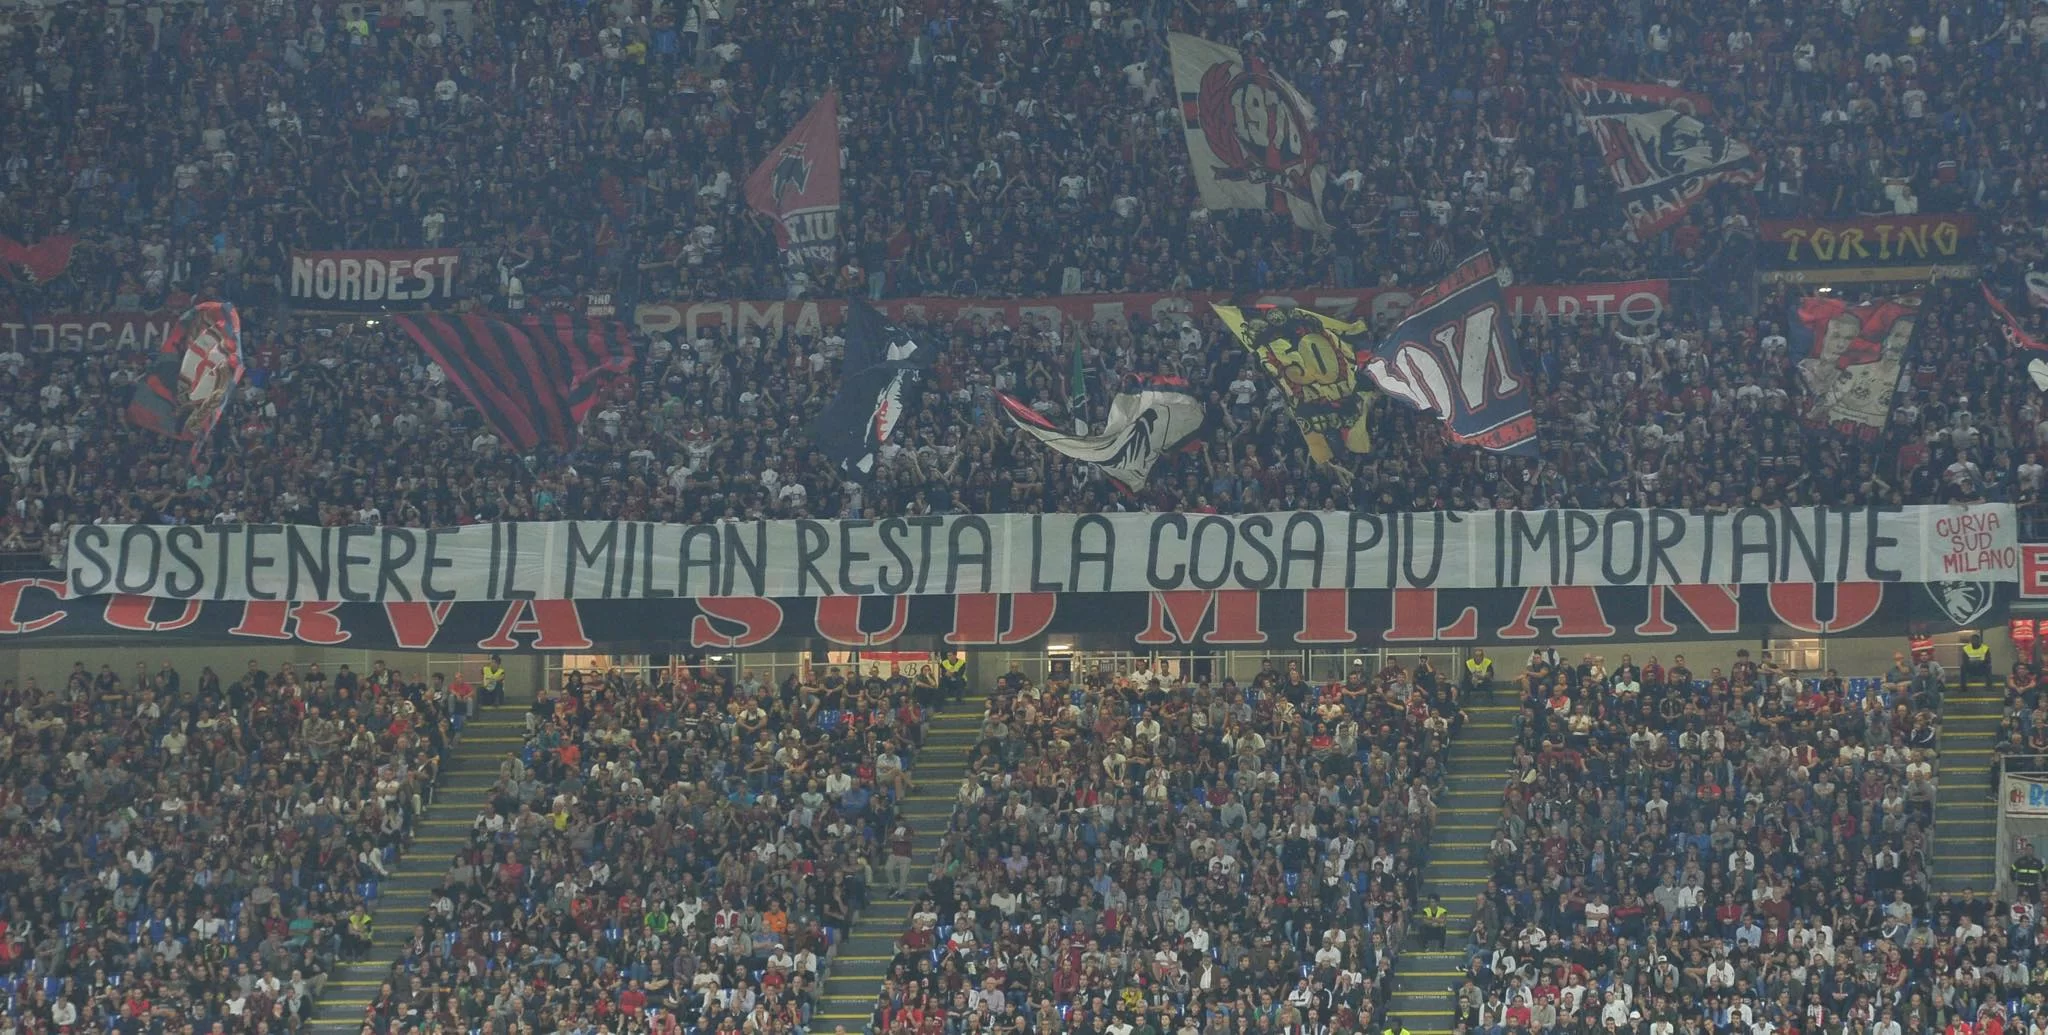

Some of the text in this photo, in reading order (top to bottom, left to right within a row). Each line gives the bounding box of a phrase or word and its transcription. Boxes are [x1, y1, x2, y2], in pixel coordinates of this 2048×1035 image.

[1782, 221, 1960, 262] TORINO
[290, 255, 459, 301] NORDEST
[634, 302, 823, 344] ROMA
[1268, 333, 1340, 385] 50
[1936, 513, 1999, 537] CURVA
[1951, 532, 1992, 553] SUD
[72, 524, 459, 602] SOSTENERE
[487, 521, 537, 600] IL
[564, 518, 766, 598] MILAN
[796, 516, 992, 595] RESTA
[1031, 514, 1116, 592] LA
[1146, 512, 1325, 589] COSA
[1495, 505, 1902, 586] IMPORTANTE
[1942, 547, 2015, 574] MILANO
[0, 577, 1883, 649] CURVA SUD MILANO
